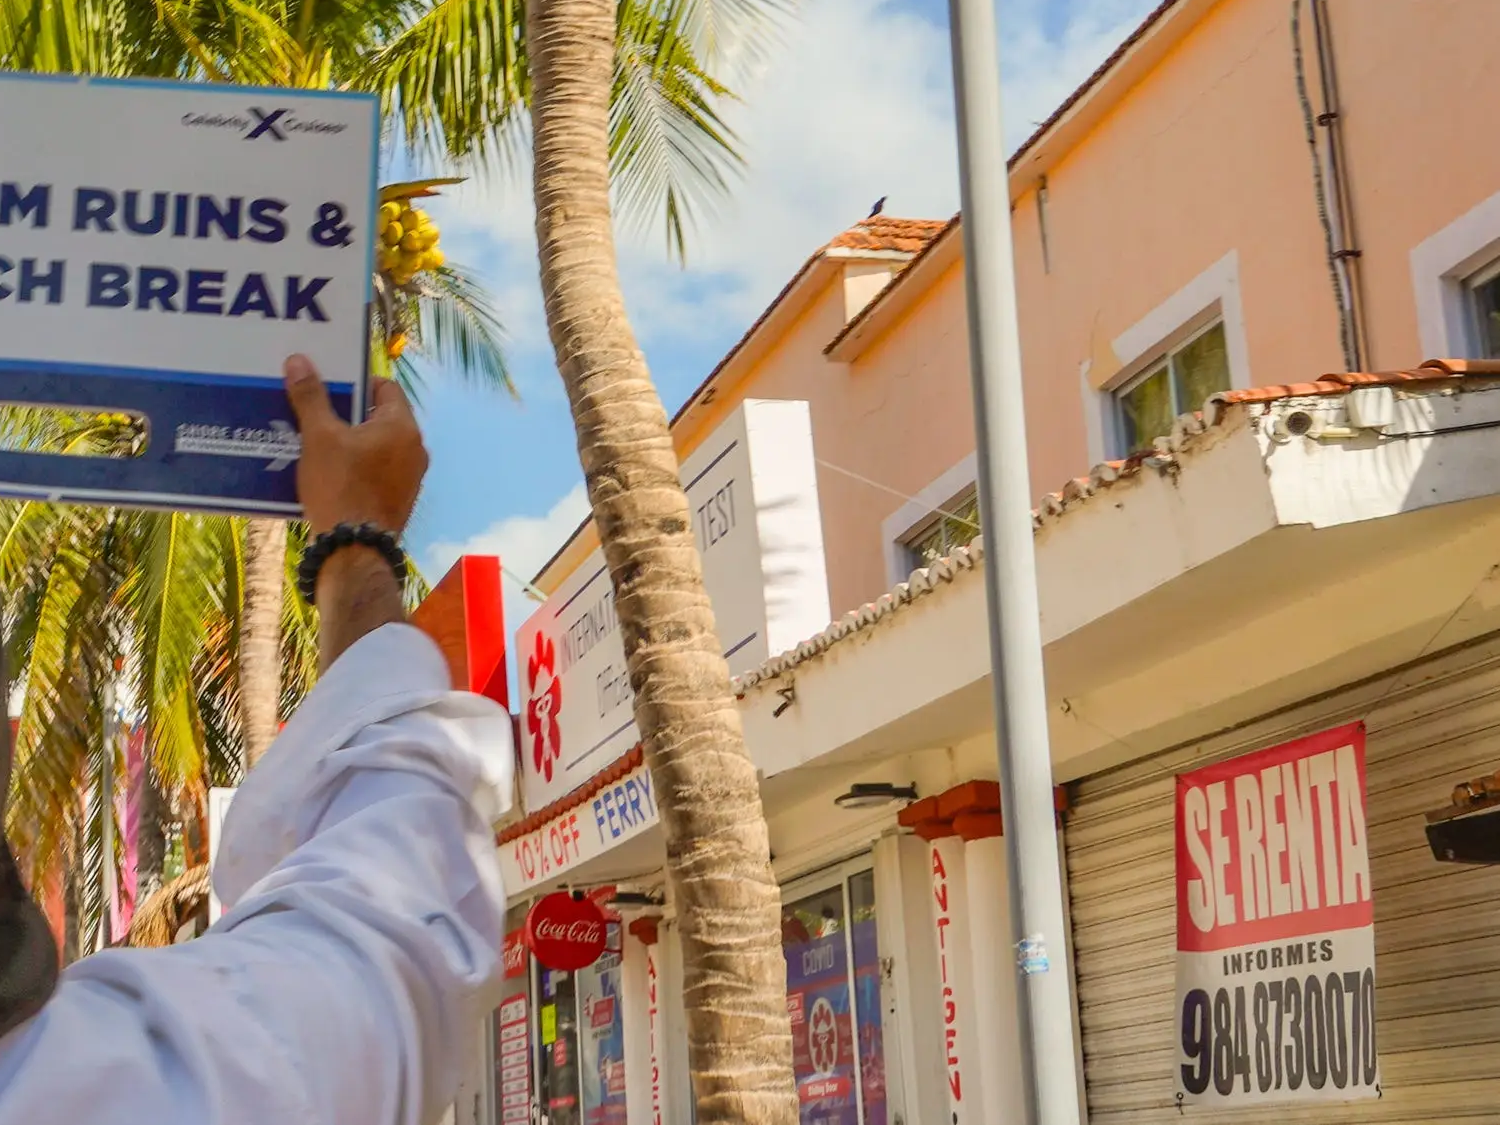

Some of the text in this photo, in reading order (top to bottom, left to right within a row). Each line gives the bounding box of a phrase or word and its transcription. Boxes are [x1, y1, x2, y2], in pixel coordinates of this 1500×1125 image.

[71, 186, 290, 244] RUINS
[308, 201, 355, 248] &
[86, 262, 334, 323] BREAK
[697, 478, 736, 552] TEST
[514, 767, 655, 883] 10% OFF FERRY
[1184, 743, 1372, 934] SE RENTA
[535, 917, 601, 944] Coca-Cola
[802, 943, 835, 976] COVID
[1223, 939, 1333, 976] INFORMES
[931, 847, 962, 1103] ANTIGEN
